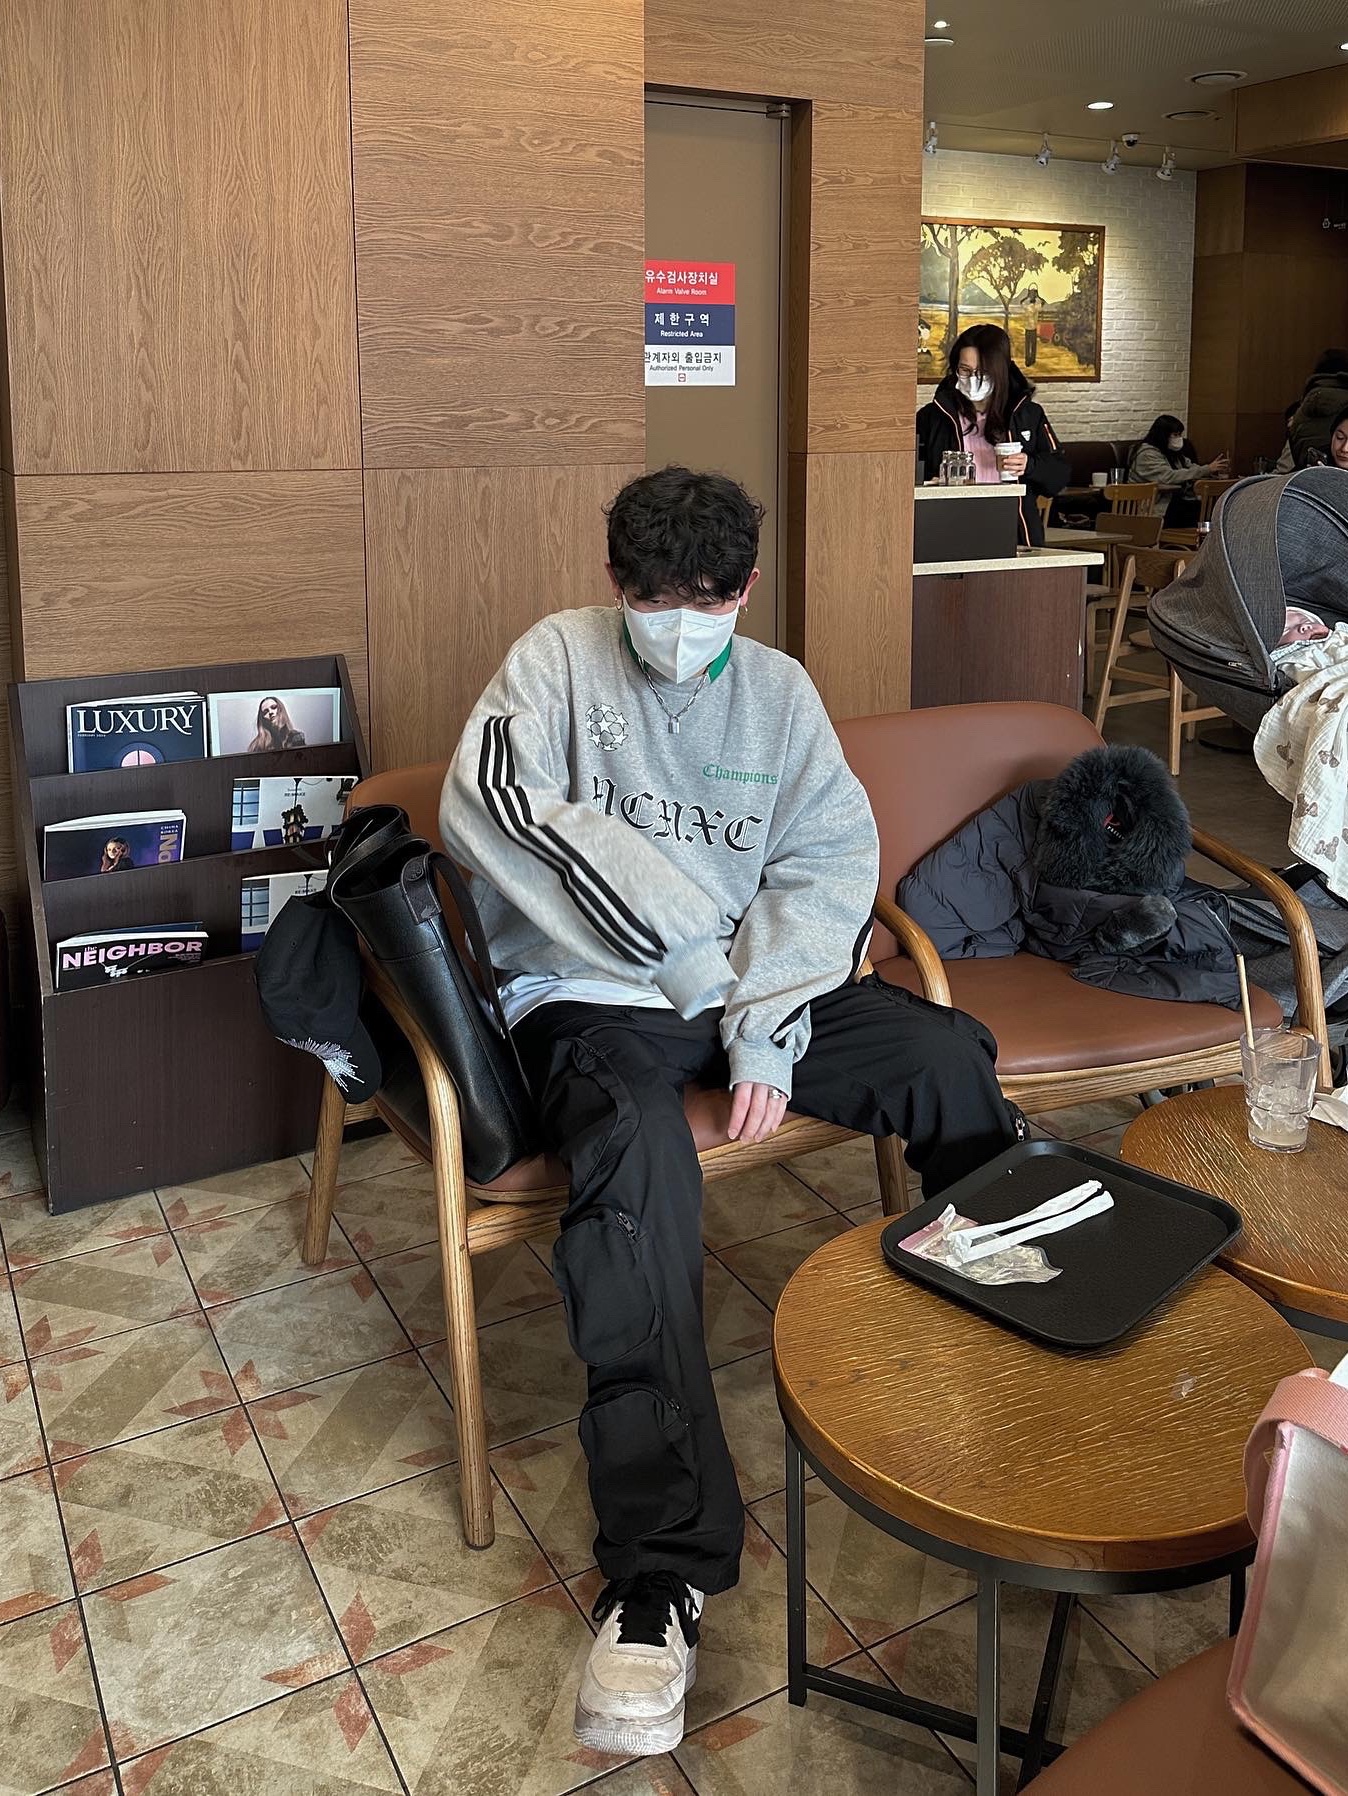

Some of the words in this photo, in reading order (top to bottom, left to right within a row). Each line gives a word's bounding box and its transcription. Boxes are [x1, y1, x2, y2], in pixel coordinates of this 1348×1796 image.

[645, 270, 718, 285] 유수검사장치실
[656, 287, 673, 295] Alarm
[674, 288, 690, 296] Valve
[690, 288, 707, 296] Room
[660, 330, 689, 338] Restricted
[689, 330, 704, 338] Area
[684, 351, 722, 364] 출입금지
[649, 364, 678, 372] Authorized
[678, 364, 701, 372] Personal
[701, 364, 714, 373] Only
[76, 704, 198, 735] LUXURY
[702, 764, 779, 785] Champions
[62, 941, 203, 969] NEIGHBOR
